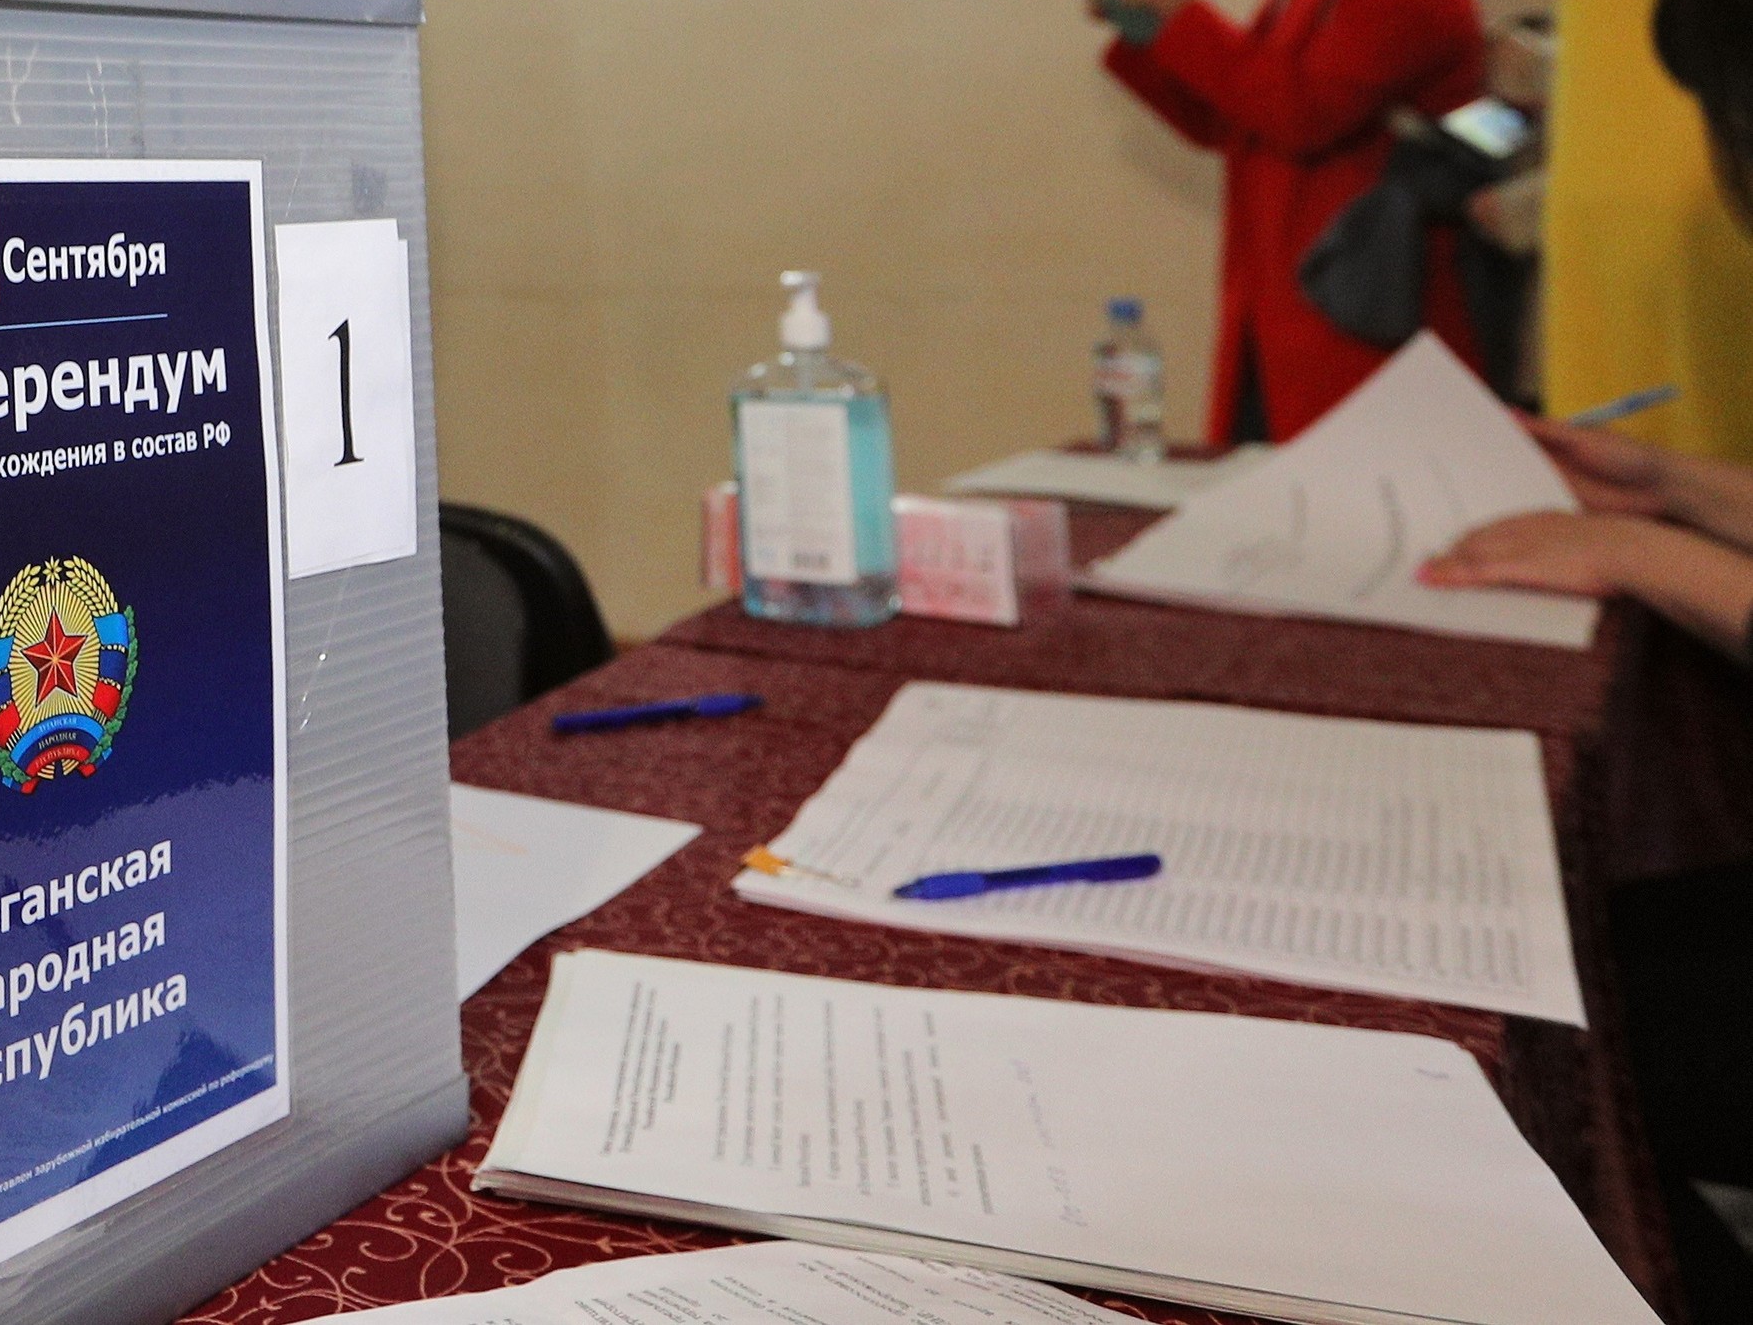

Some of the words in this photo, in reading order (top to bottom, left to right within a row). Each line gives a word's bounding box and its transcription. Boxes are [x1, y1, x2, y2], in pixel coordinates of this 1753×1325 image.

[2, 233, 166, 286] Сентября
[327, 318, 365, 467] 1
[113, 442, 125, 461] в
[131, 431, 197, 458] состав
[203, 421, 231, 450] РФ
